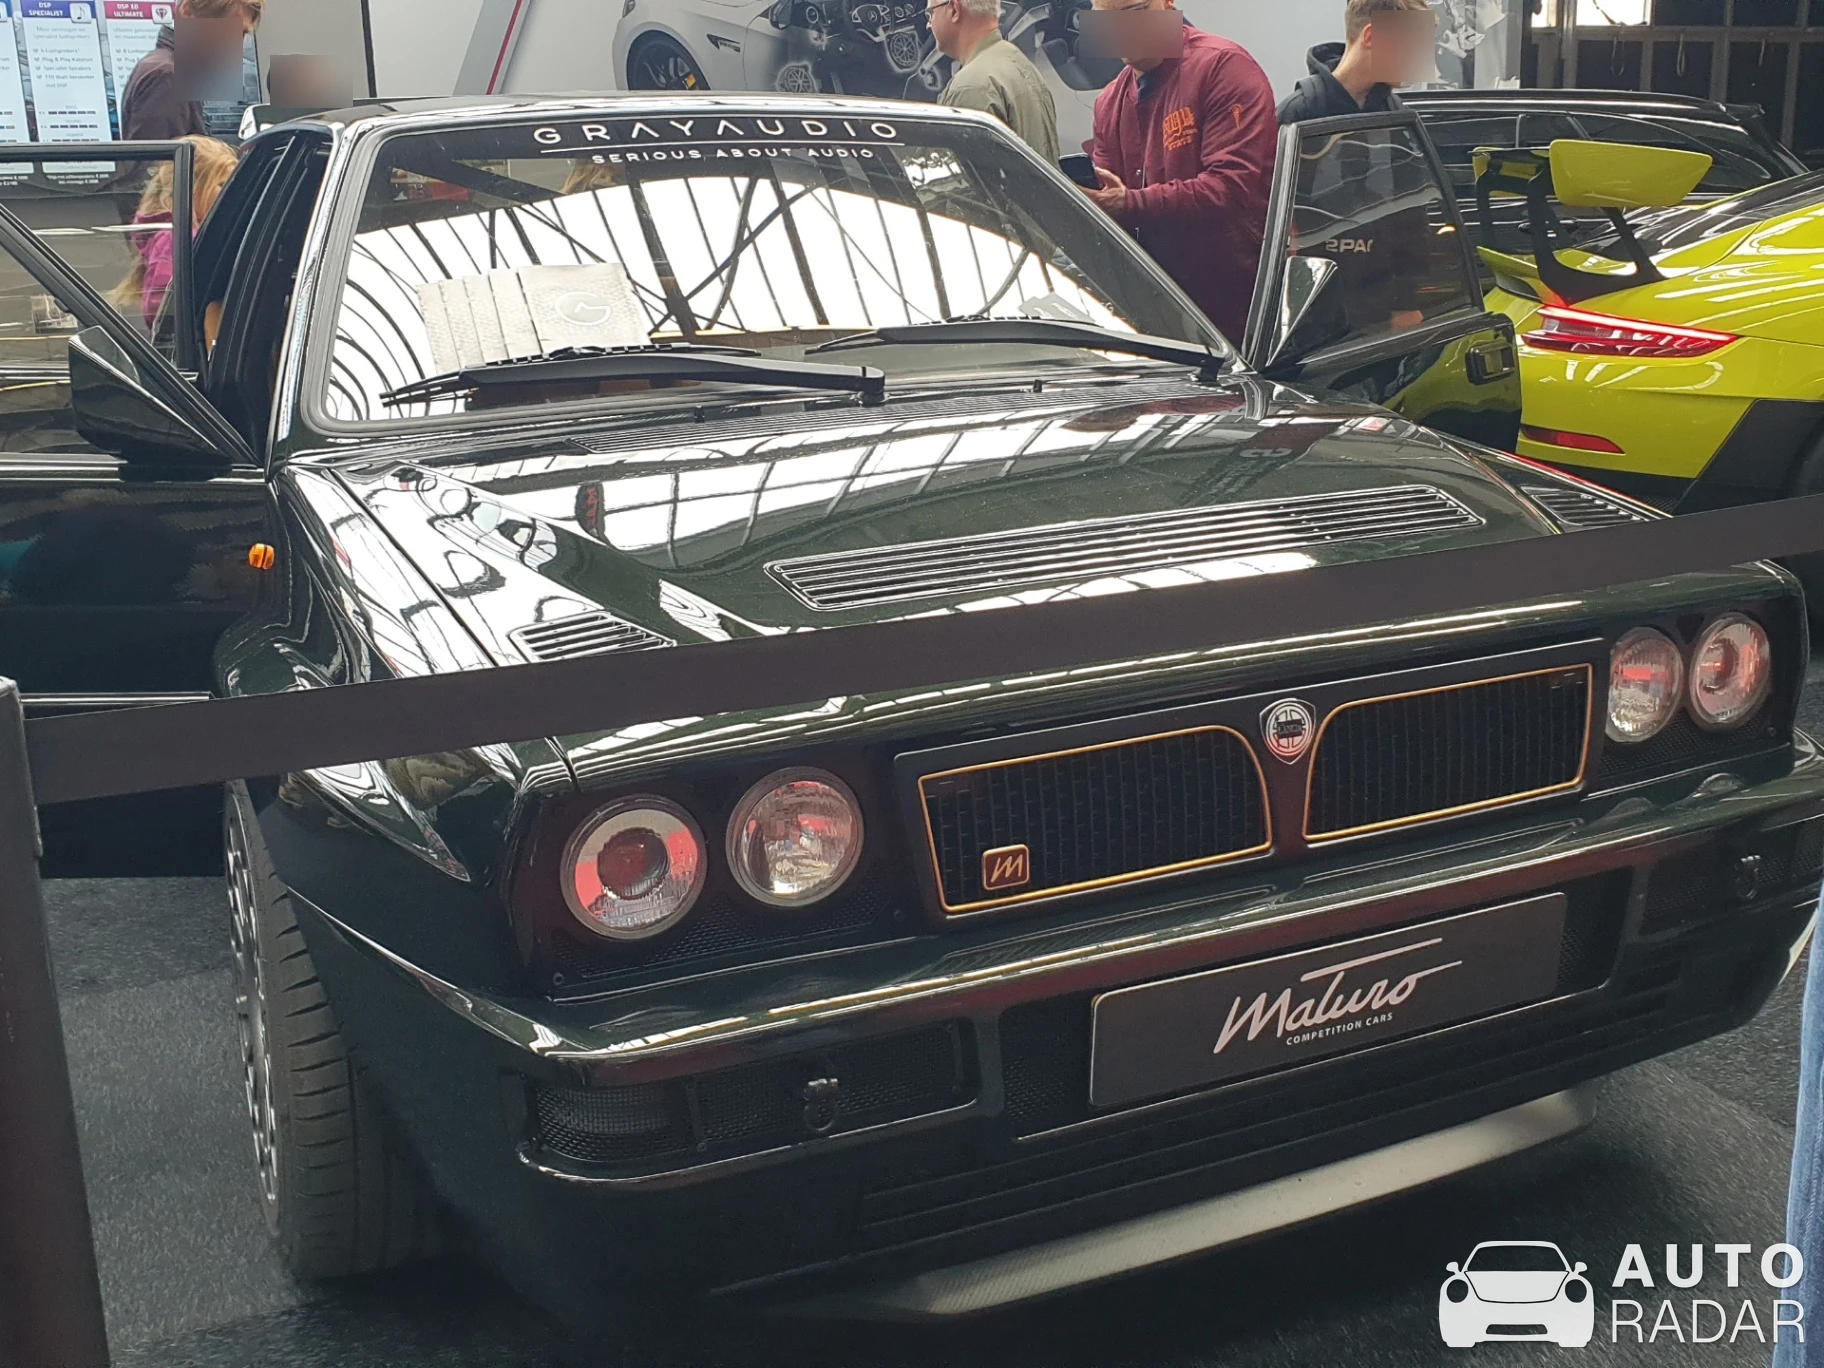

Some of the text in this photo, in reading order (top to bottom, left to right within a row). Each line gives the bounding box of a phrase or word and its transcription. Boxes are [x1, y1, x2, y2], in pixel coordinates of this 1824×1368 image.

[28, 9, 64, 17] SPECIALIST
[113, 10, 144, 18] ULTIMATE
[533, 119, 897, 144] GRAYAUDIO
[592, 147, 873, 164] SERIOUS ABOUT AUDIO
[1213, 938, 1462, 1054] Maturo
[1286, 1012, 1393, 1046] COMPETITION CARS
